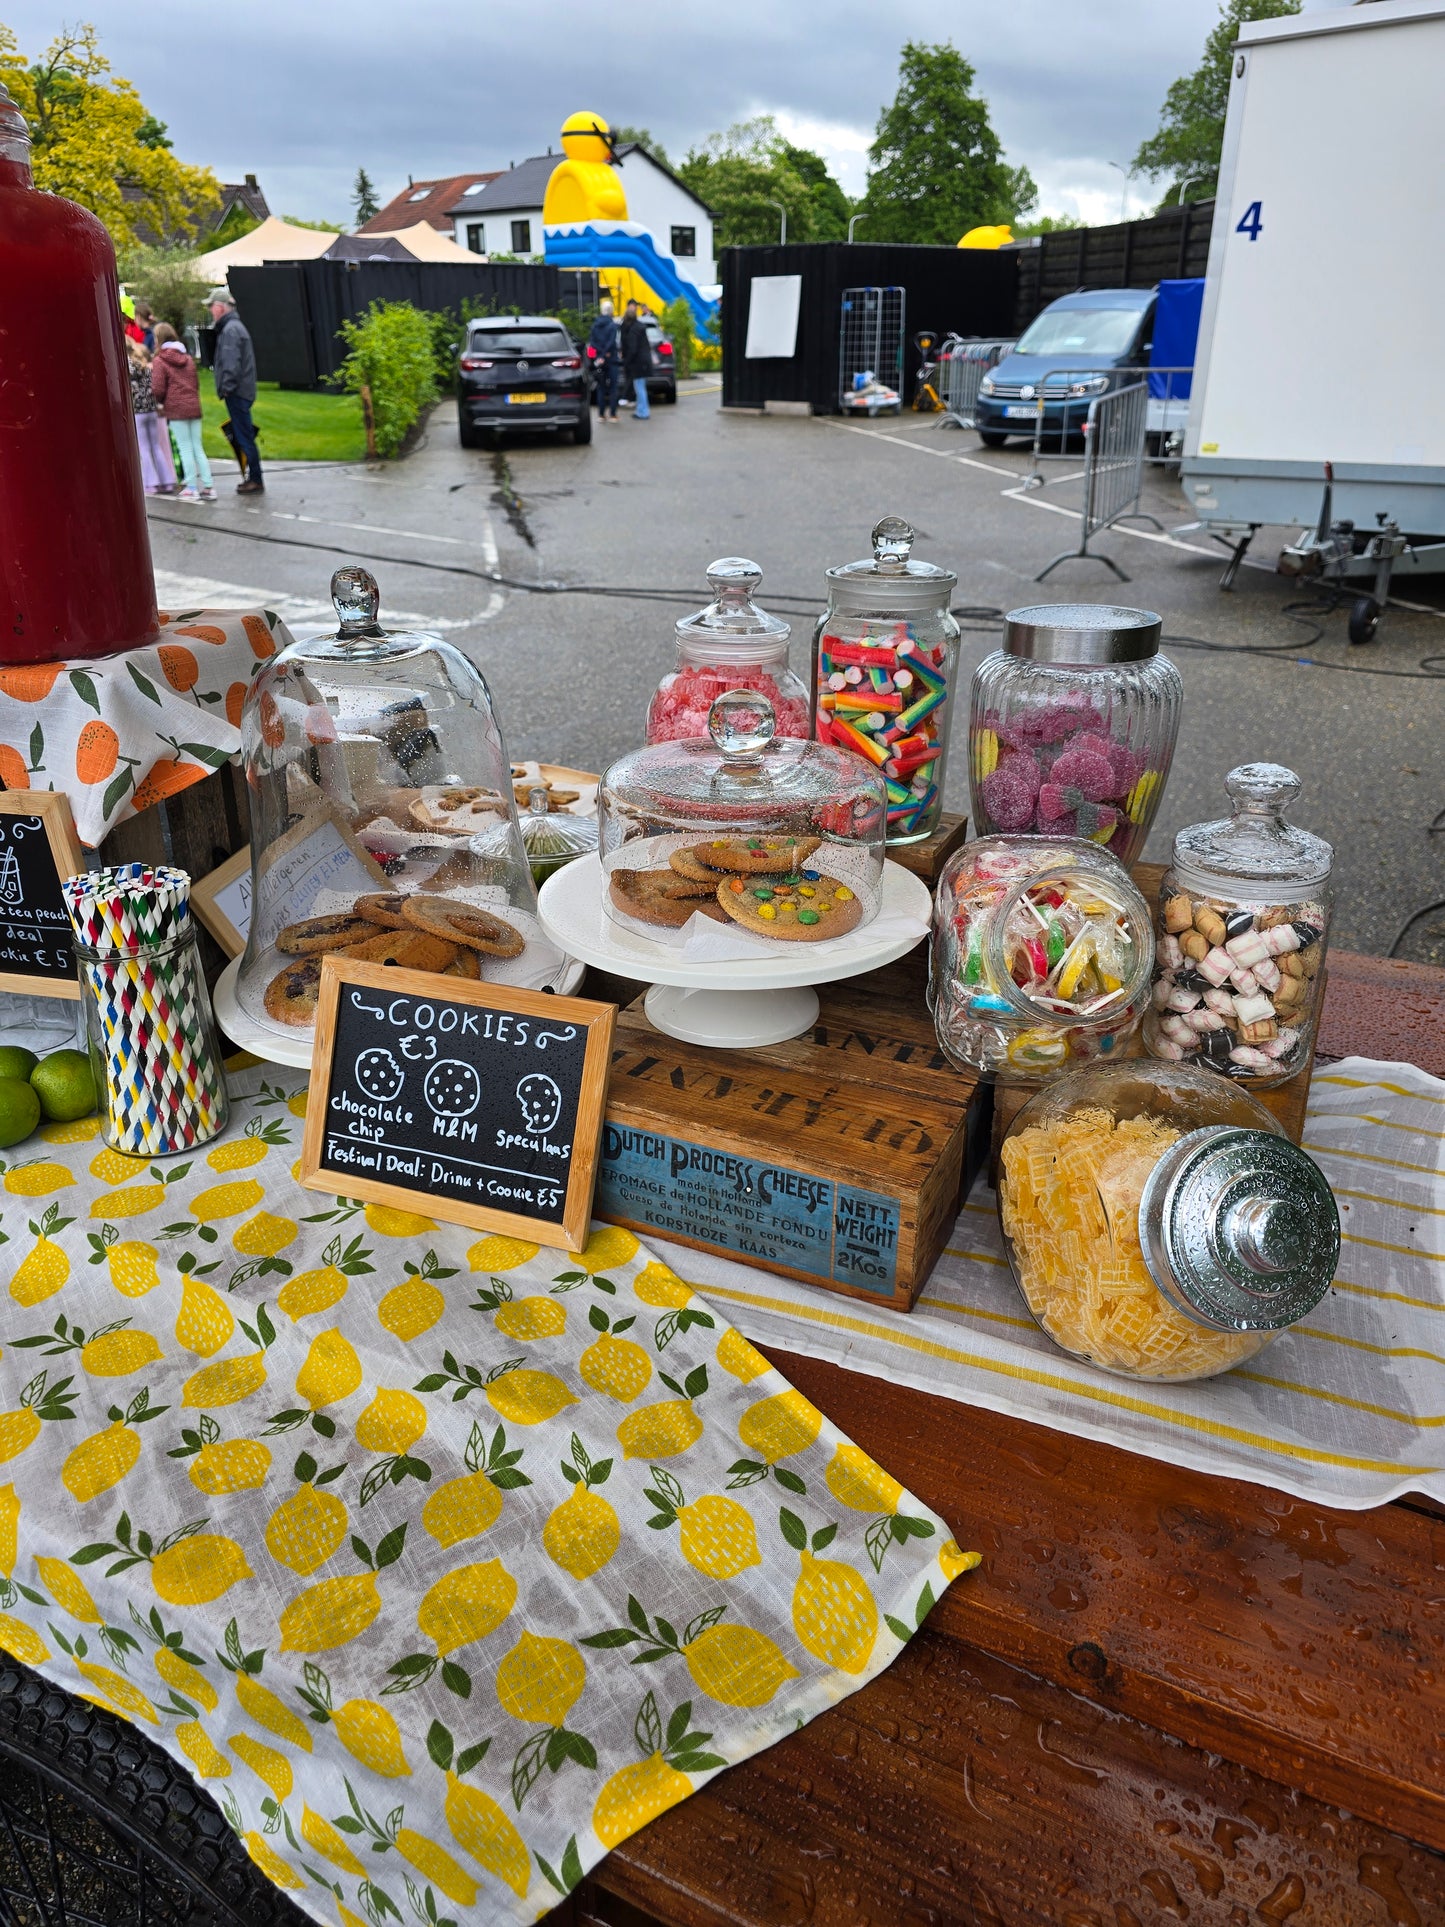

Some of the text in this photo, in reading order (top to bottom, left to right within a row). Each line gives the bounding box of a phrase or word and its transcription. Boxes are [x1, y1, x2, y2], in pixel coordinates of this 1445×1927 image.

[1236, 201, 1263, 241] 4
[8, 906, 33, 919] tea
[35, 908, 70, 923] peach
[6, 925, 44, 943] deal
[388, 998, 530, 1046] COOKIES
[399, 1034, 437, 1060] €3
[331, 1090, 414, 1125] chocolate
[348, 1117, 385, 1143] chip
[432, 1115, 478, 1143] M&M
[327, 1139, 382, 1172] Festival
[386, 1155, 426, 1177] Deal:
[486, 1180, 535, 1202] Cookie
[603, 1125, 830, 1214] DUTCH PROCESS CHEESE
[602, 1167, 829, 1242] FROMAGE de HOLLANDE FONDU
[677, 1178, 707, 1193] made
[721, 1188, 762, 1209] Holland
[839, 1196, 895, 1226] NETT.
[645, 1210, 778, 1258] KORSTLOZE KAAS
[735, 1222, 752, 1235] sin
[759, 1230, 807, 1250] corteza
[835, 1214, 897, 1249] WEIGHT
